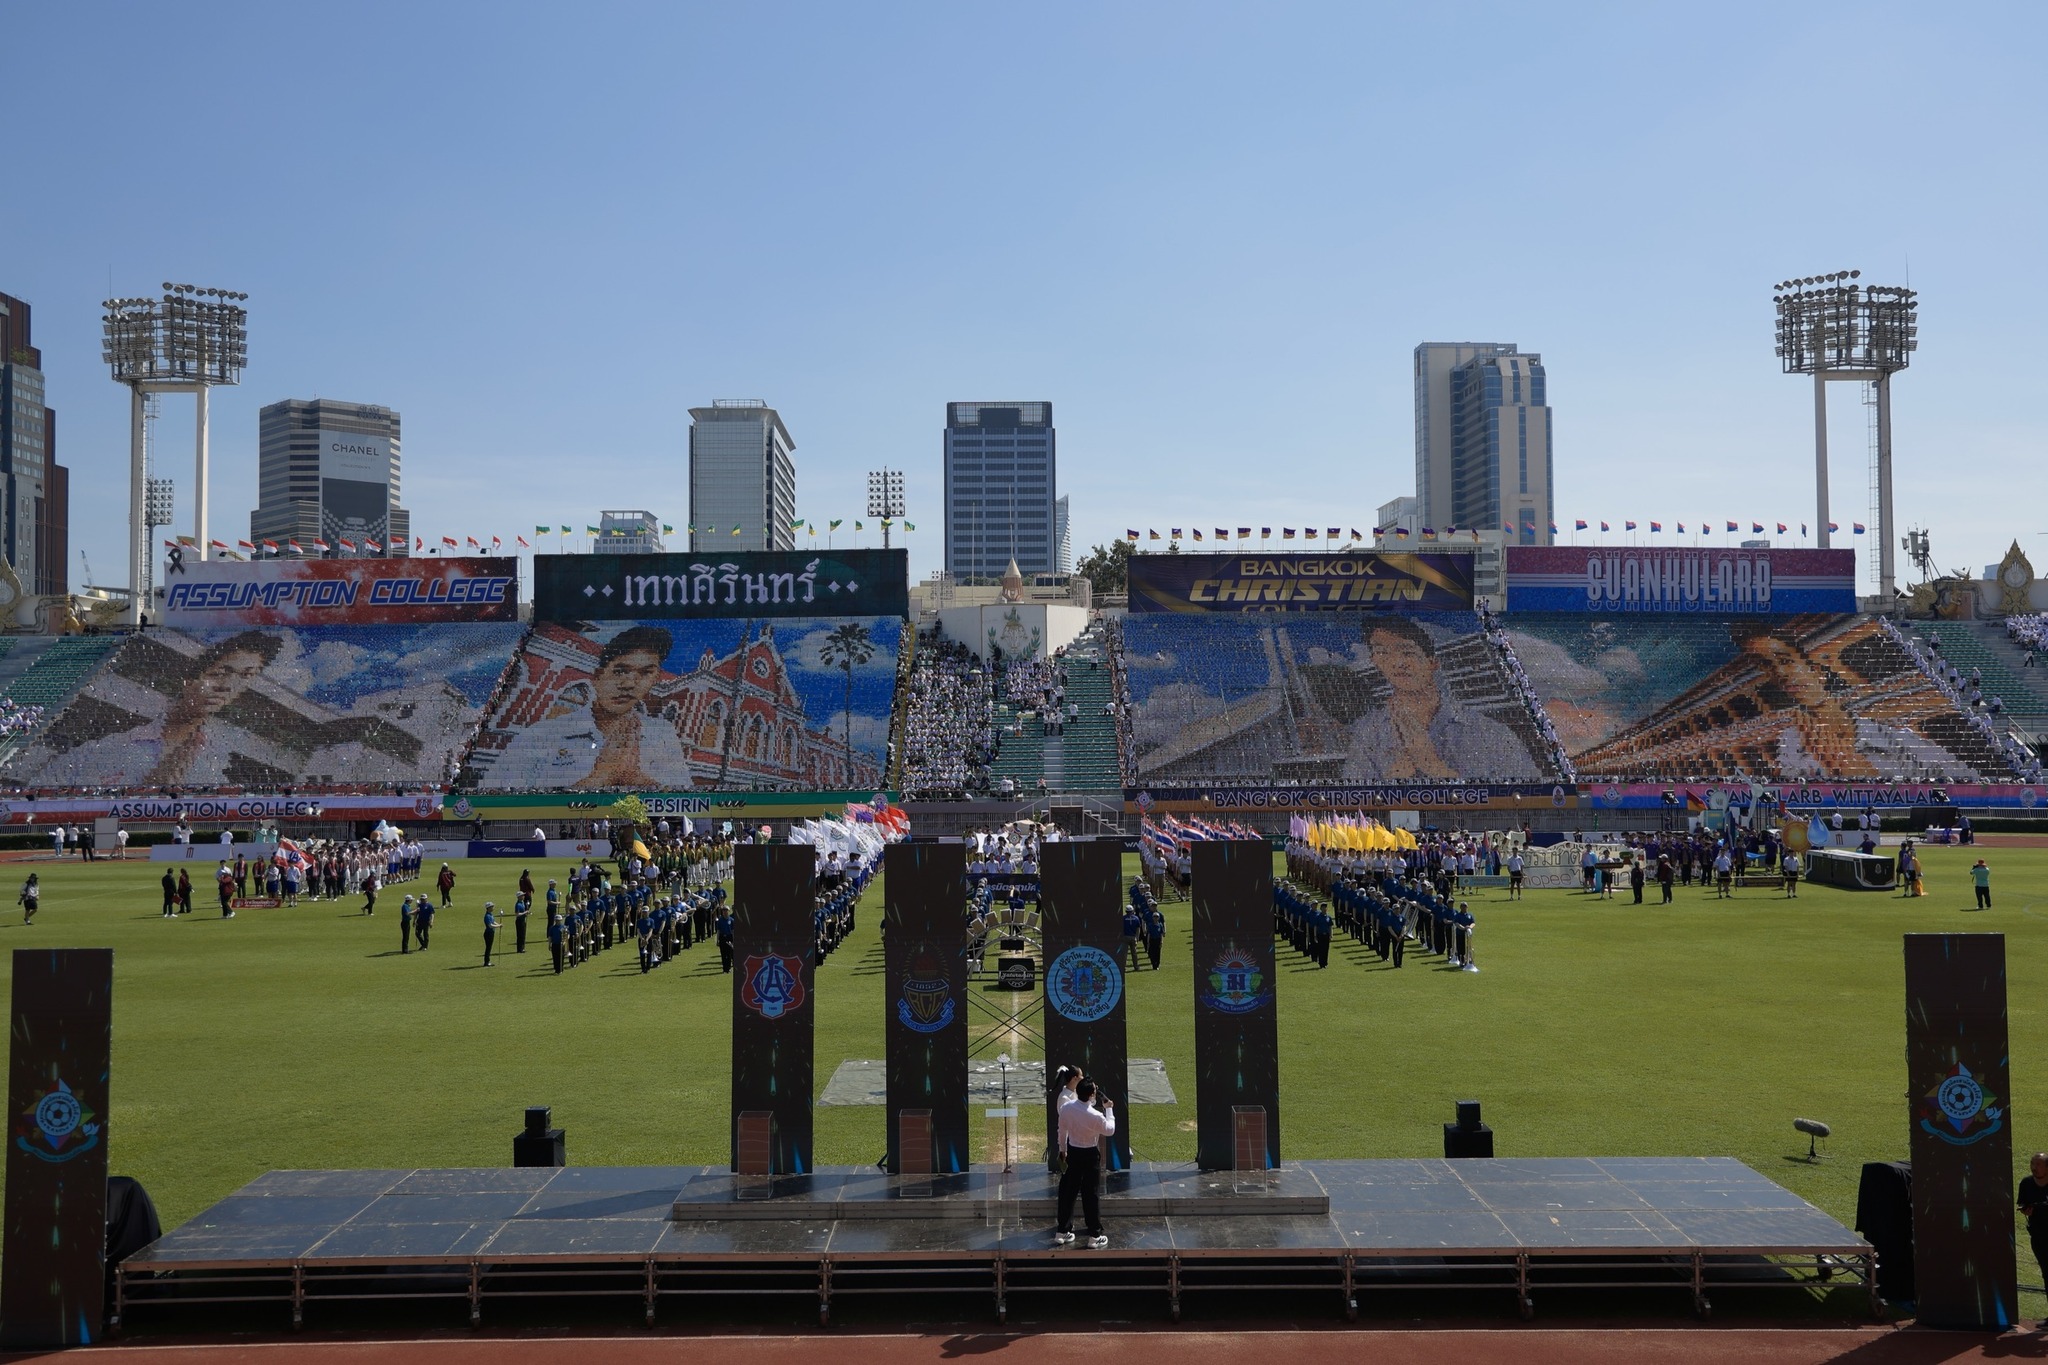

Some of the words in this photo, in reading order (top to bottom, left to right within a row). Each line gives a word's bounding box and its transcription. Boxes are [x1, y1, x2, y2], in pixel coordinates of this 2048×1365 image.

[332, 443, 380, 456] CHANEL
[1240, 560, 1376, 576] BANGKOK
[623, 557, 821, 607] เทพศิรินทร์
[1586, 553, 1772, 608] SUANKULARB
[166, 580, 361, 609] ASSUMPTION
[369, 576, 513, 606] COLLEGE
[1188, 579, 1429, 602] CHRISTIAN
[640, 797, 711, 814] EBSIRIN
[1213, 791, 1304, 809] BANGKOK
[1308, 789, 1403, 807] CHRISTIAN
[1406, 788, 1489, 805] COLLEGE
[108, 802, 228, 819] ASSUMPTION
[238, 801, 320, 817] COLLEGE
[1523, 873, 1572, 888] hopee
